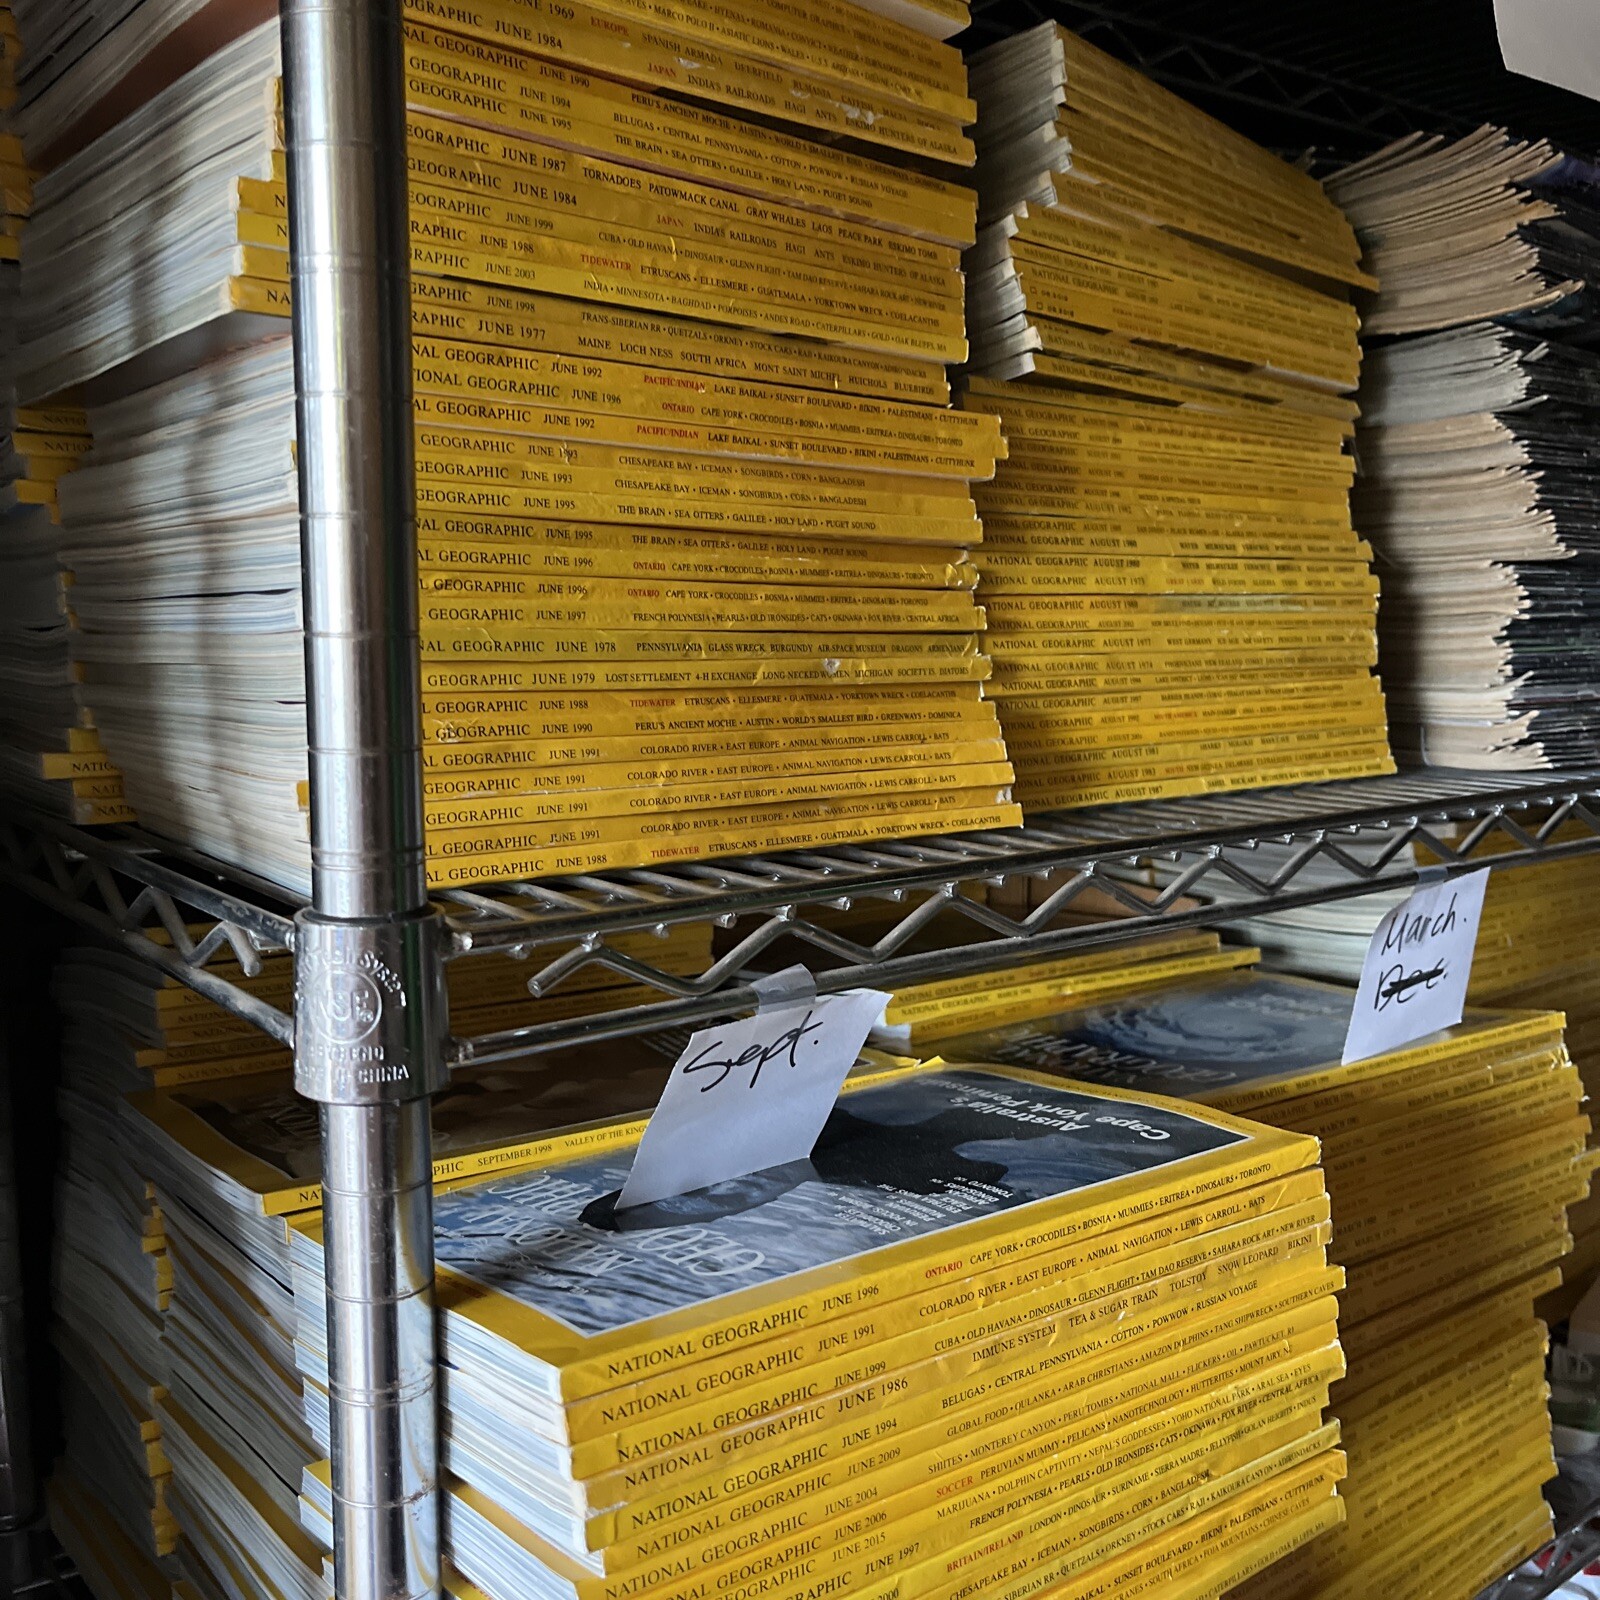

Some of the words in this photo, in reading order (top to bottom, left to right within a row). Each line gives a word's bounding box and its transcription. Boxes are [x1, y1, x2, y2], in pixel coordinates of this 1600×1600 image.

[434, 36, 528, 70] GEOGRAPHIC
[539, 66, 565, 81] JUNE
[570, 74, 589, 87] 1990
[632, 94, 661, 108] PERU'S
[664, 100, 699, 120] ANCIENT
[702, 114, 730, 129] MOCHE
[410, 58, 506, 91] GEOGRAPHIC
[520, 87, 546, 103] JUNE
[551, 95, 570, 108] 1994
[614, 113, 654, 130] BELUGAS
[663, 126, 701, 143] CENTRAL
[705, 137, 762, 159] PENNSYLVANIA
[771, 156, 801, 169] COTTON
[410, 79, 507, 114] GEOGRAPHIC
[520, 109, 547, 124] JUNE
[552, 117, 572, 130] 1995
[615, 135, 632, 146] THE
[635, 140, 662, 153] BRAIN
[672, 150, 686, 161] SEA
[690, 156, 722, 170] OTTERS
[502, 147, 537, 166] JUNE
[542, 157, 566, 171] 1987
[583, 167, 641, 189] TORNADOES
[649, 184, 706, 204] PATOWMACK
[710, 198, 739, 213] CANAL
[746, 207, 768, 221] GRAY
[772, 213, 806, 228] WHALES
[839, 229, 861, 242] PEACE
[864, 236, 883, 247] PARK
[580, 254, 632, 271] TIDEWATER
[640, 265, 691, 281] ETRUSCANS
[701, 276, 748, 292] ELLESMERE
[758, 287, 806, 301] GUATEMALA
[814, 297, 856, 310] YORKTOWN
[859, 305, 883, 316] WRECK
[478, 319, 514, 336] JUNE
[520, 327, 546, 340] 1977
[578, 336, 611, 350] MAINE
[620, 343, 647, 355] LOCH
[650, 347, 673, 358] NESS
[681, 352, 711, 364] SOUTH
[714, 357, 747, 369] AFRICA
[754, 363, 779, 375] MONT
[783, 367, 807, 377] SAINT
[437, 401, 531, 423] GEOGRAPHIC
[543, 414, 570, 426] JUNE
[575, 417, 595, 429] 1992
[708, 433, 729, 442] LAKE
[732, 436, 761, 446] BAIKAL
[770, 440, 799, 450] SUNSET
[855, 449, 876, 457] BIKINI
[884, 451, 929, 463] PALESTINIANS
[935, 457, 974, 467] CUTTYHUNK
[633, 562, 665, 570] ONTARIO
[987, 556, 1031, 566] NATIONAL
[1036, 557, 1088, 567] GEOGRAPHIC
[453, 641, 544, 652] GEOGRAPHIC
[556, 641, 587, 652] JUNE
[595, 642, 616, 652] 1978
[637, 643, 702, 651] PENNSYLVANIA
[736, 644, 765, 652] WRECK
[770, 644, 812, 653] BURGUNDY
[993, 640, 1037, 649] NATIONAL
[1042, 640, 1095, 648] GEOGRAPHIC
[1103, 639, 1133, 648] AUGUST
[428, 674, 522, 686] GEOGRAPHIC
[532, 673, 566, 684] JUNE
[572, 673, 595, 684] 1979
[630, 672, 691, 681] SETTLEMENT
[1002, 681, 1043, 691] NATIONAL
[1046, 679, 1097, 689] GEOGRAPHIC
[426, 807, 523, 825] GEOGRAPHIC
[537, 804, 563, 815] JUNE
[569, 803, 587, 812] 1991
[630, 797, 681, 807] COLORADO
[684, 794, 710, 803] RIVER
[720, 792, 741, 800] EAST
[744, 789, 777, 798] EUROPE
[787, 786, 818, 795] ANIMAL
[821, 782, 867, 792] NAVIGATION
[875, 779, 897, 787] LEWIS
[899, 777, 932, 785] CARROLL
[449, 860, 544, 881] GEOGRAPHIC
[556, 857, 582, 868] JUNE
[587, 855, 607, 865] 1988
[652, 847, 699, 858] TIDEWATER
[709, 841, 757, 852] ETRUSCANS
[821, 830, 868, 840] GUATEMALA
[683, 1010, 823, 1092] Sept.
[1029, 1102, 1089, 1121] York
[1095, 1116, 1171, 1140] Cape
[478, 1148, 531, 1167] SEPTEMBER
[534, 1145, 552, 1155] 1998
[565, 1136, 594, 1148] VALLEY
[597, 1133, 607, 1141] OF
[609, 1129, 623, 1139] THE
[608, 1341, 697, 1379] NATIONAL
[702, 1306, 809, 1349] GEOGRAPHIC
[822, 1293, 853, 1311] JUNE
[857, 1285, 879, 1301] 1996
[926, 1261, 962, 1278] ONTARIO
[970, 1251, 992, 1264] CAPE
[995, 1243, 1019, 1256] YORK
[1025, 1225, 1077, 1247] CROCODILES
[1083, 1214, 1112, 1230] BOSNIA
[1118, 1200, 1154, 1219] MUMMIES
[1160, 1191, 1191, 1206] ERITREA
[1196, 1175, 1234, 1193] DINOSAURS
[1240, 1163, 1271, 1179] TORONTO
[1029, 1298, 1072, 1319] DINOSAUR
[1078, 1285, 1106, 1302] GLENN
[602, 1384, 691, 1424] NATIONAL
[696, 1346, 805, 1392] GEOGRAPHIC
[818, 1333, 848, 1352] JUNE
[853, 1324, 875, 1340] 1991
[838, 1389, 875, 1412] JUNE
[881, 1379, 908, 1396] 1986
[973, 1340, 1015, 1362] IMMUNE
[1018, 1324, 1056, 1345] SYSTEM
[632, 1487, 718, 1529] NATIONAL
[723, 1444, 829, 1493] GEOGRAPHIC
[842, 1427, 873, 1448] JUNE
[877, 1418, 897, 1435] 1994
[942, 1385, 986, 1409] BELUGAS
[995, 1367, 1036, 1388] CENTRAL
[847, 1458, 876, 1476] JUNE
[878, 1448, 900, 1464] 2009
[937, 1476, 973, 1498] SOCCER
[981, 1455, 1025, 1479] PERUVIAN
[1027, 1440, 1060, 1461] MUMMY
[947, 1530, 1023, 1573] BRITAIN/IRELAND
[1030, 1512, 1062, 1533] LONDON
[1068, 1492, 1106, 1516] DINOSAUR
